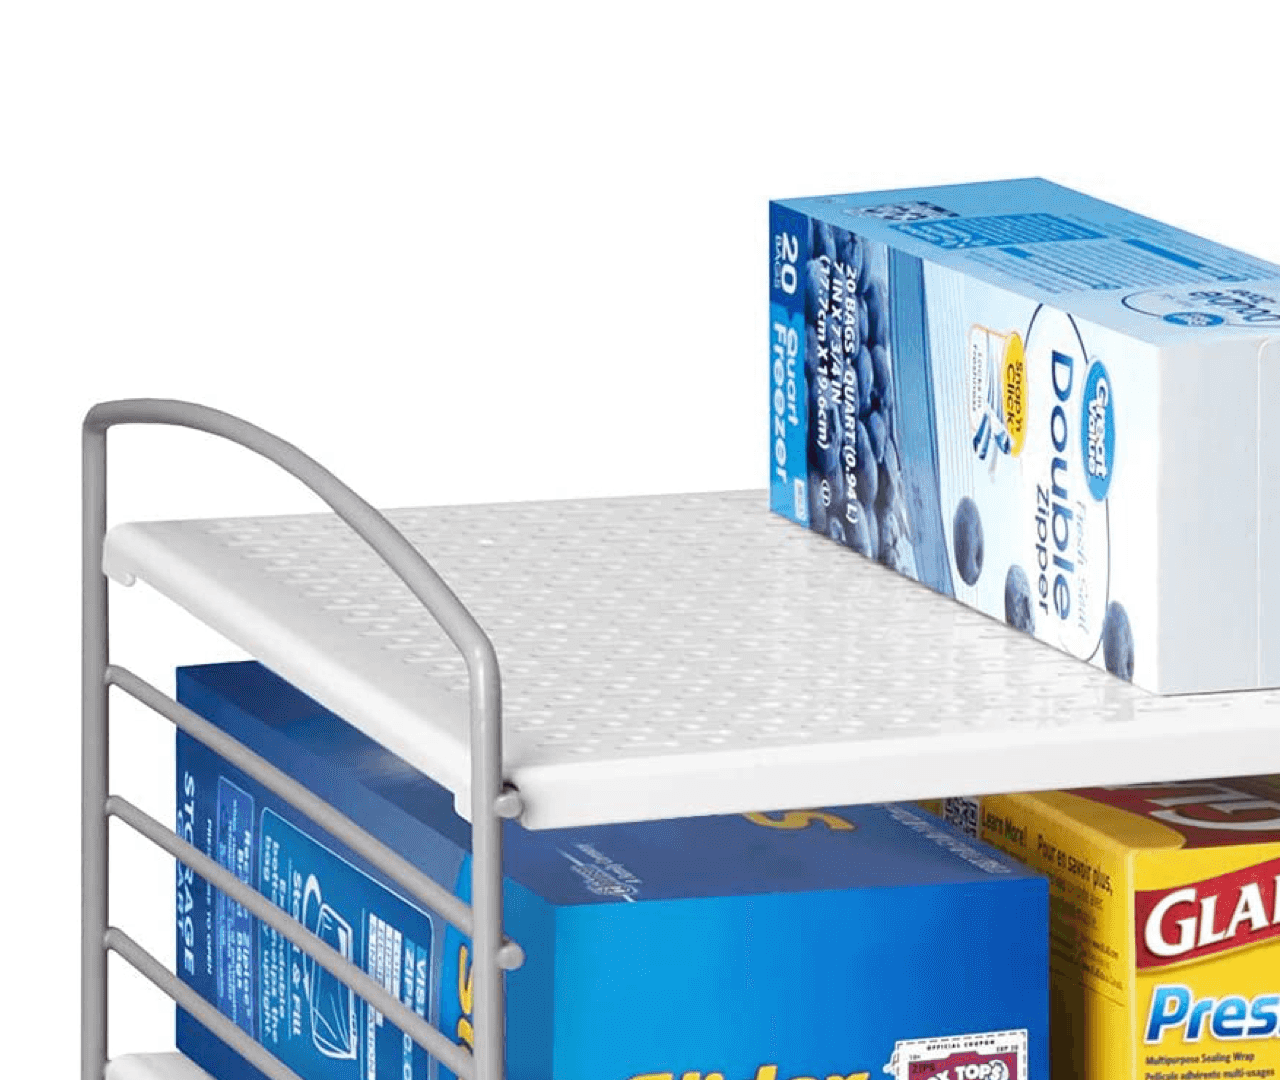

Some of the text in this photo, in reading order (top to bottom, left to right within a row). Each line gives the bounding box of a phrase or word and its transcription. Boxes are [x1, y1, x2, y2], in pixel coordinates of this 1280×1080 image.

[781, 231, 799, 295] 20
[845, 264, 858, 294] 20
[844, 297, 857, 354] BAGS
[773, 321, 788, 484] Freezer
[786, 328, 799, 426] Quart
[843, 365, 858, 443] QUART
[1050, 349, 1075, 621] Double
